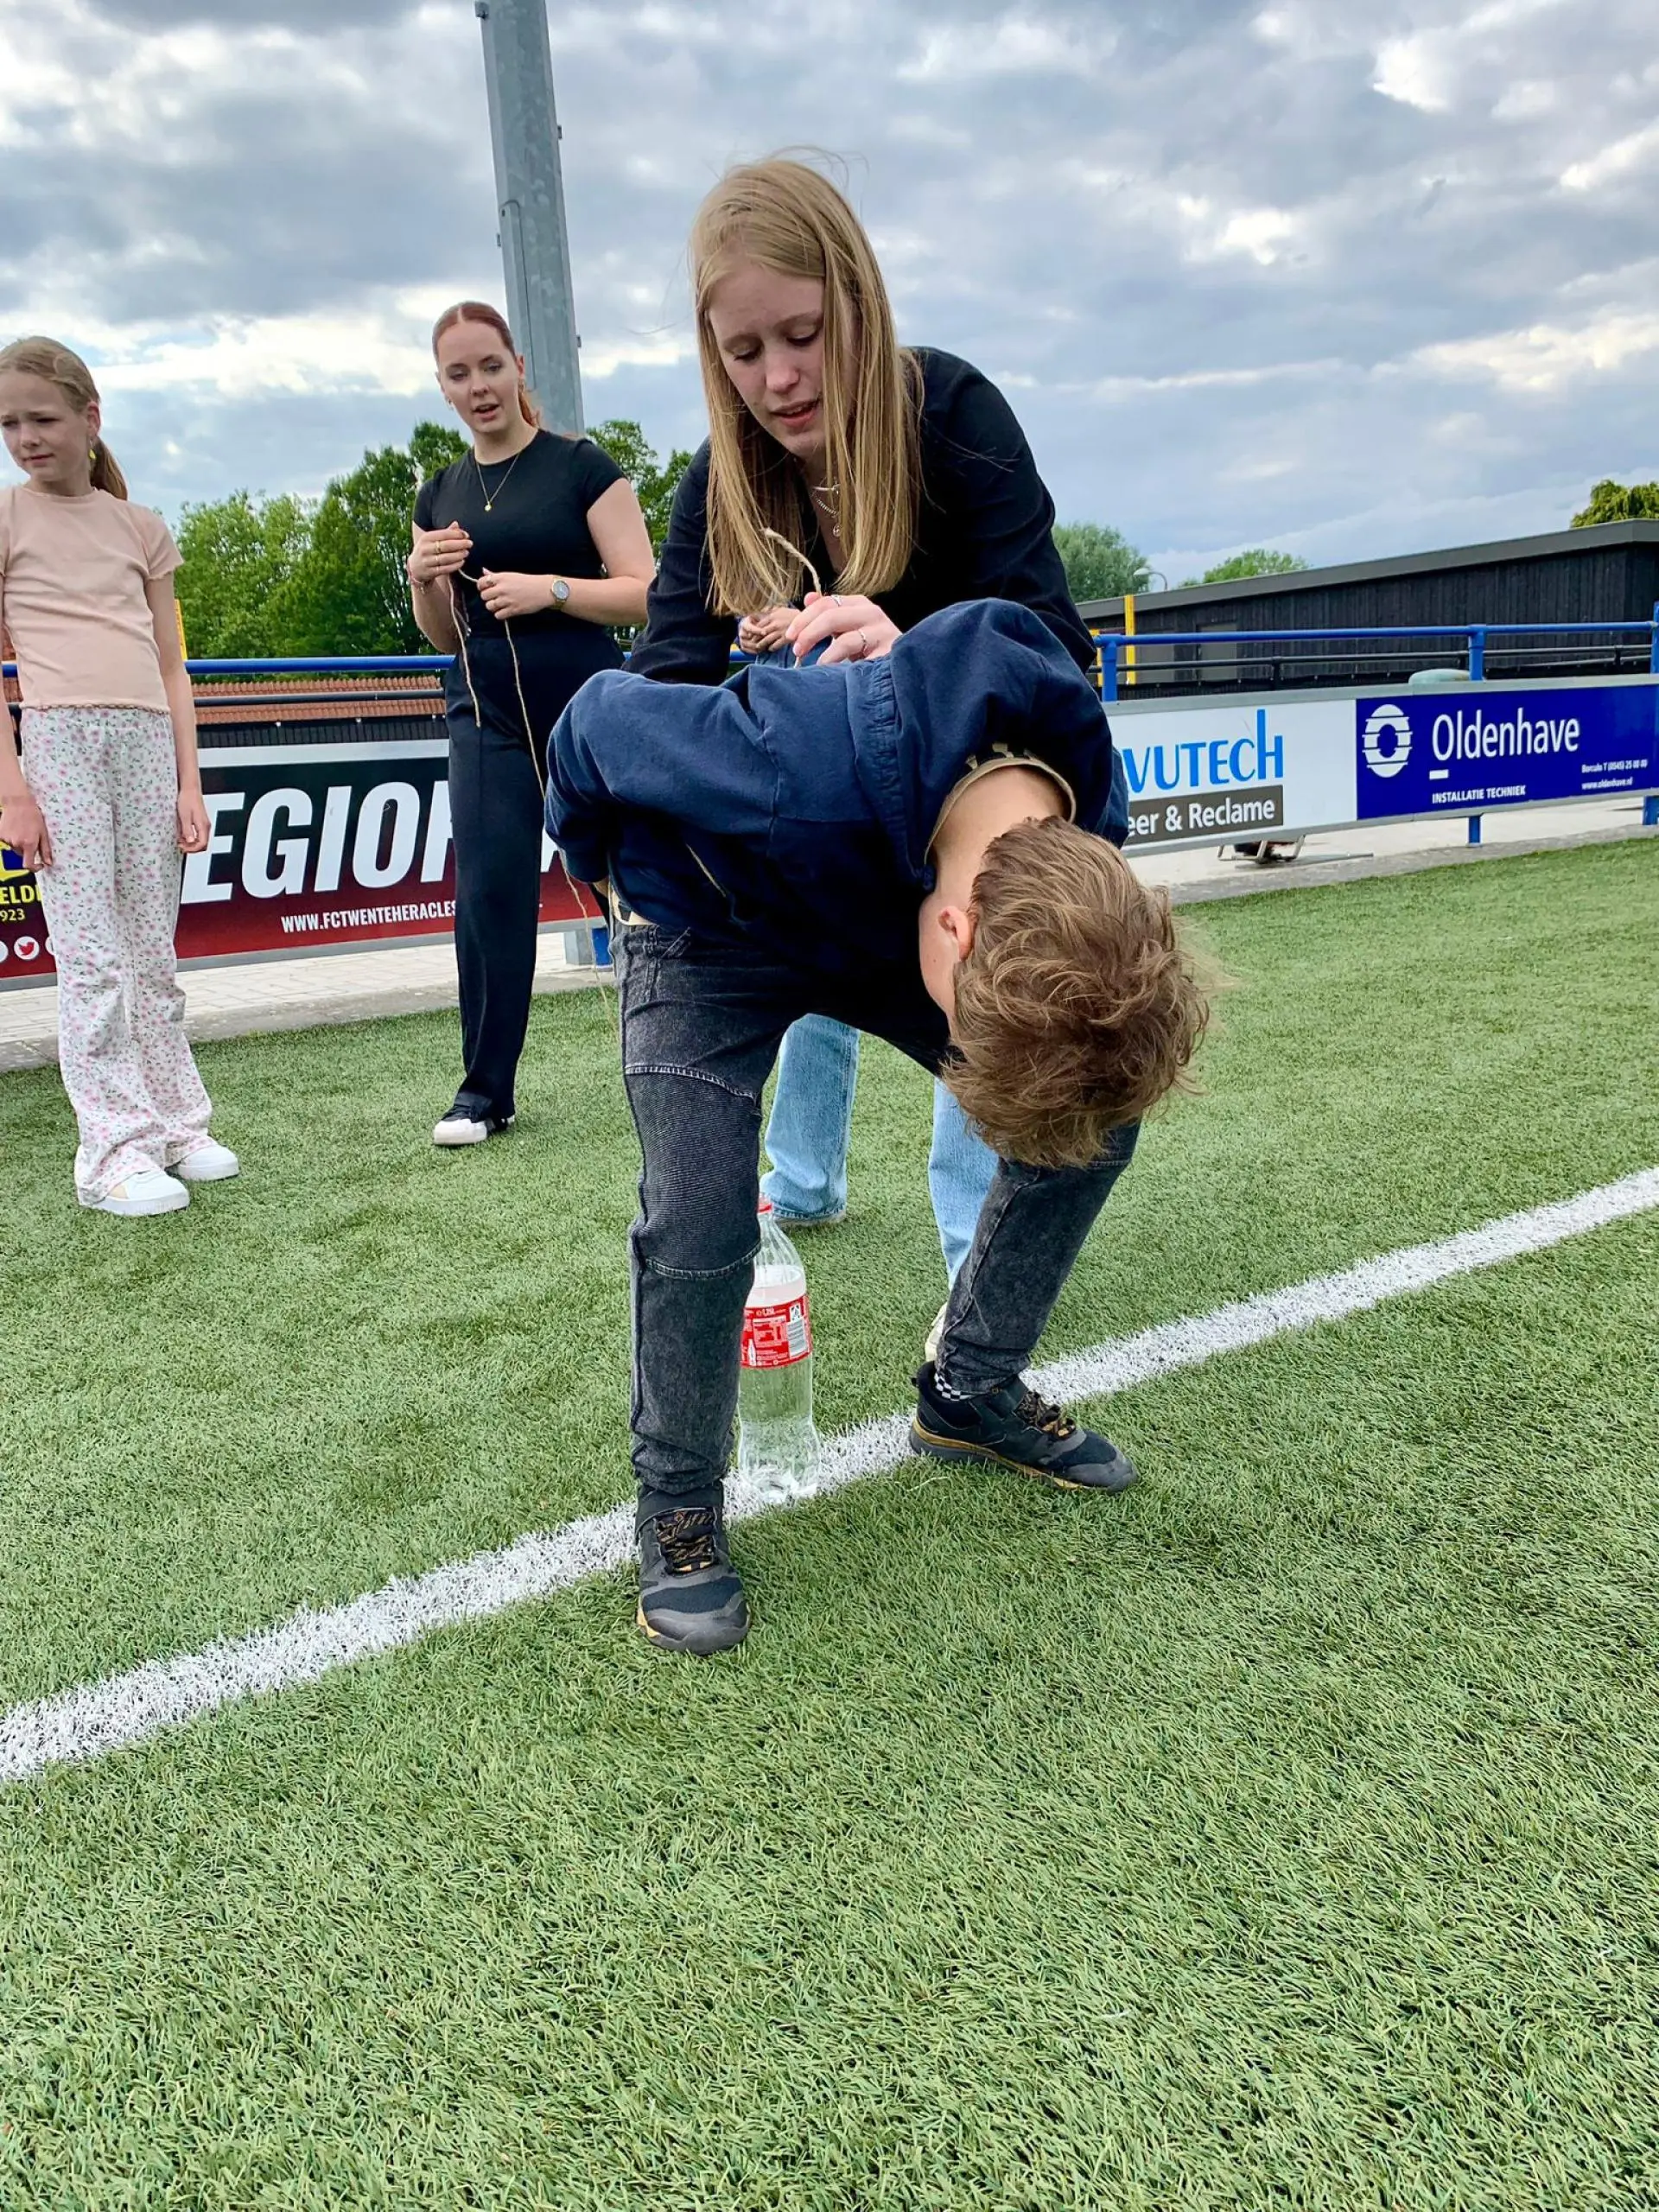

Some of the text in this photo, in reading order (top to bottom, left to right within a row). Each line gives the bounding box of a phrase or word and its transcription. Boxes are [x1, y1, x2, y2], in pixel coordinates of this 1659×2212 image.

[1432, 707, 1580, 761] Oldenhave
[1432, 785, 1526, 804] INSTALLATIE TECHNIEK
[1165, 804, 1183, 831] &
[1189, 797, 1275, 829] Reclame
